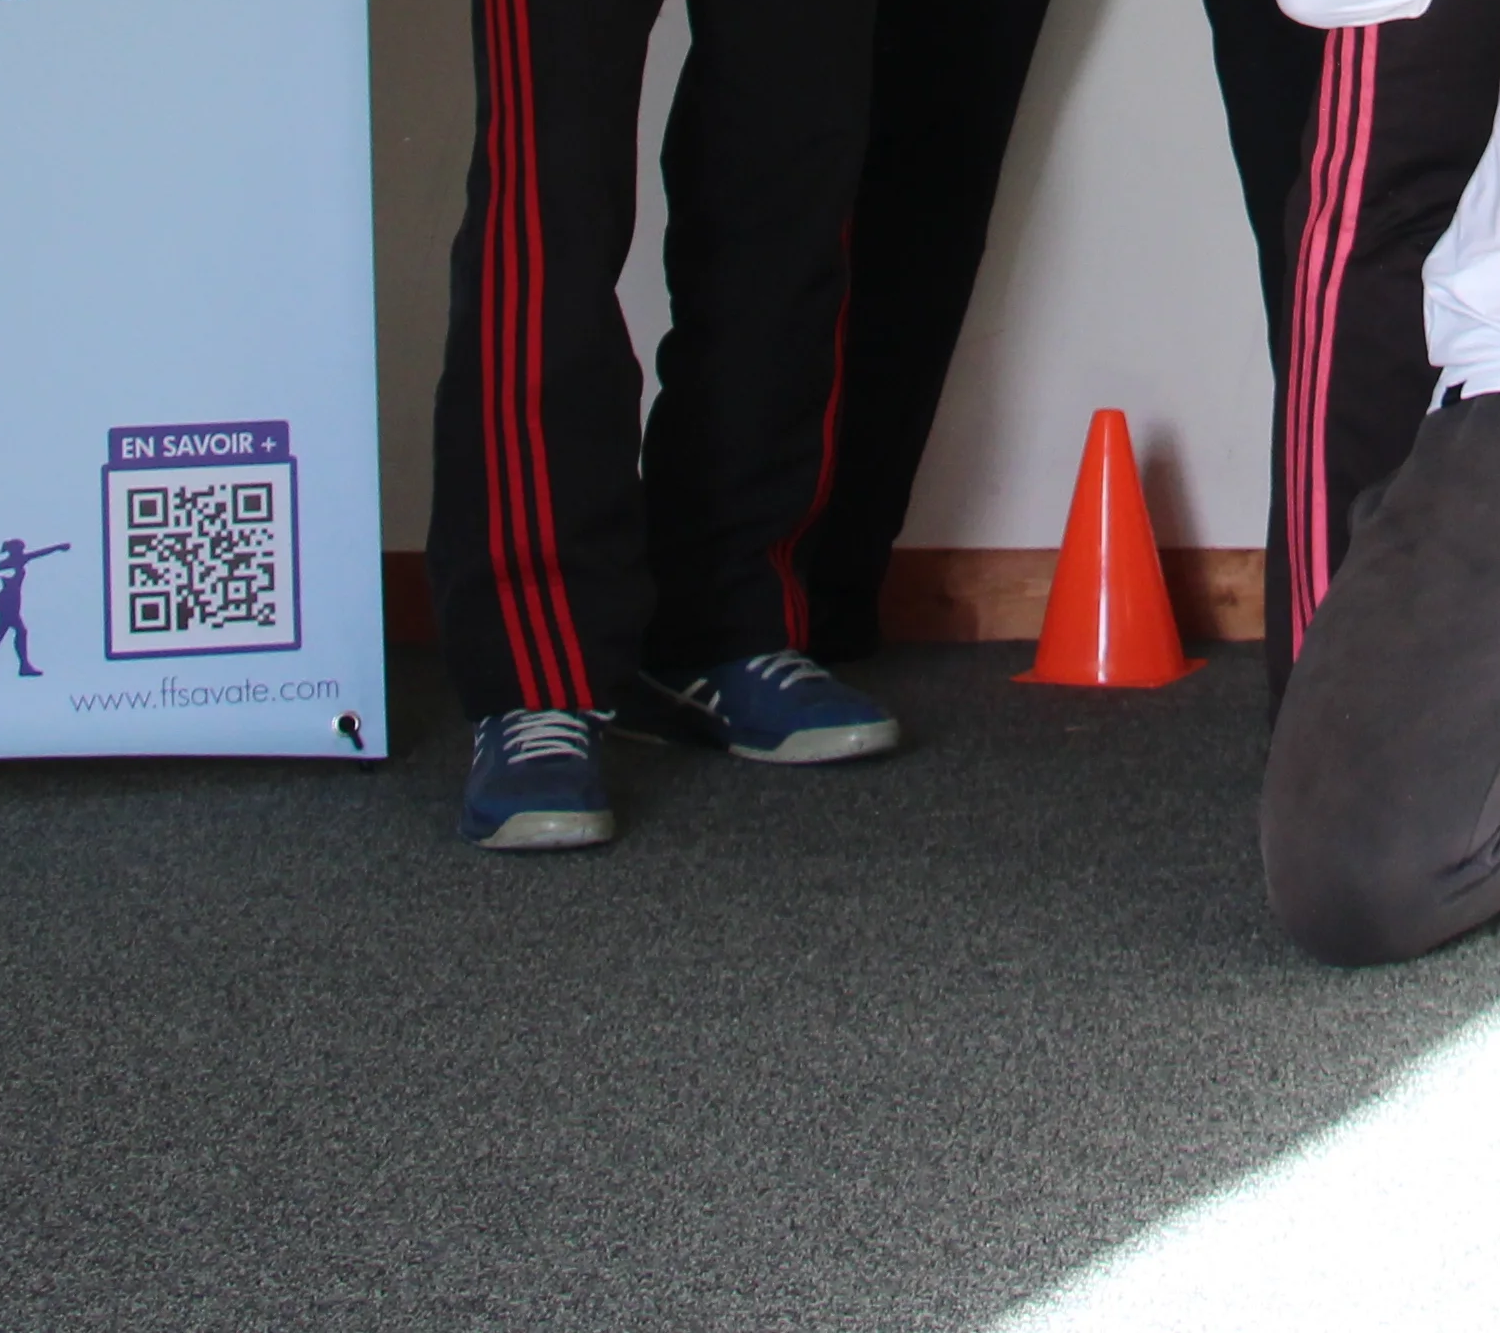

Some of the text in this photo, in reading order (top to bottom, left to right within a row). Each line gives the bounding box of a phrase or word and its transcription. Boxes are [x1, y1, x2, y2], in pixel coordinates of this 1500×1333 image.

[121, 436, 155, 460] EN
[162, 432, 253, 457] SAVOIR
[70, 676, 340, 712] www.ffsavate.com
